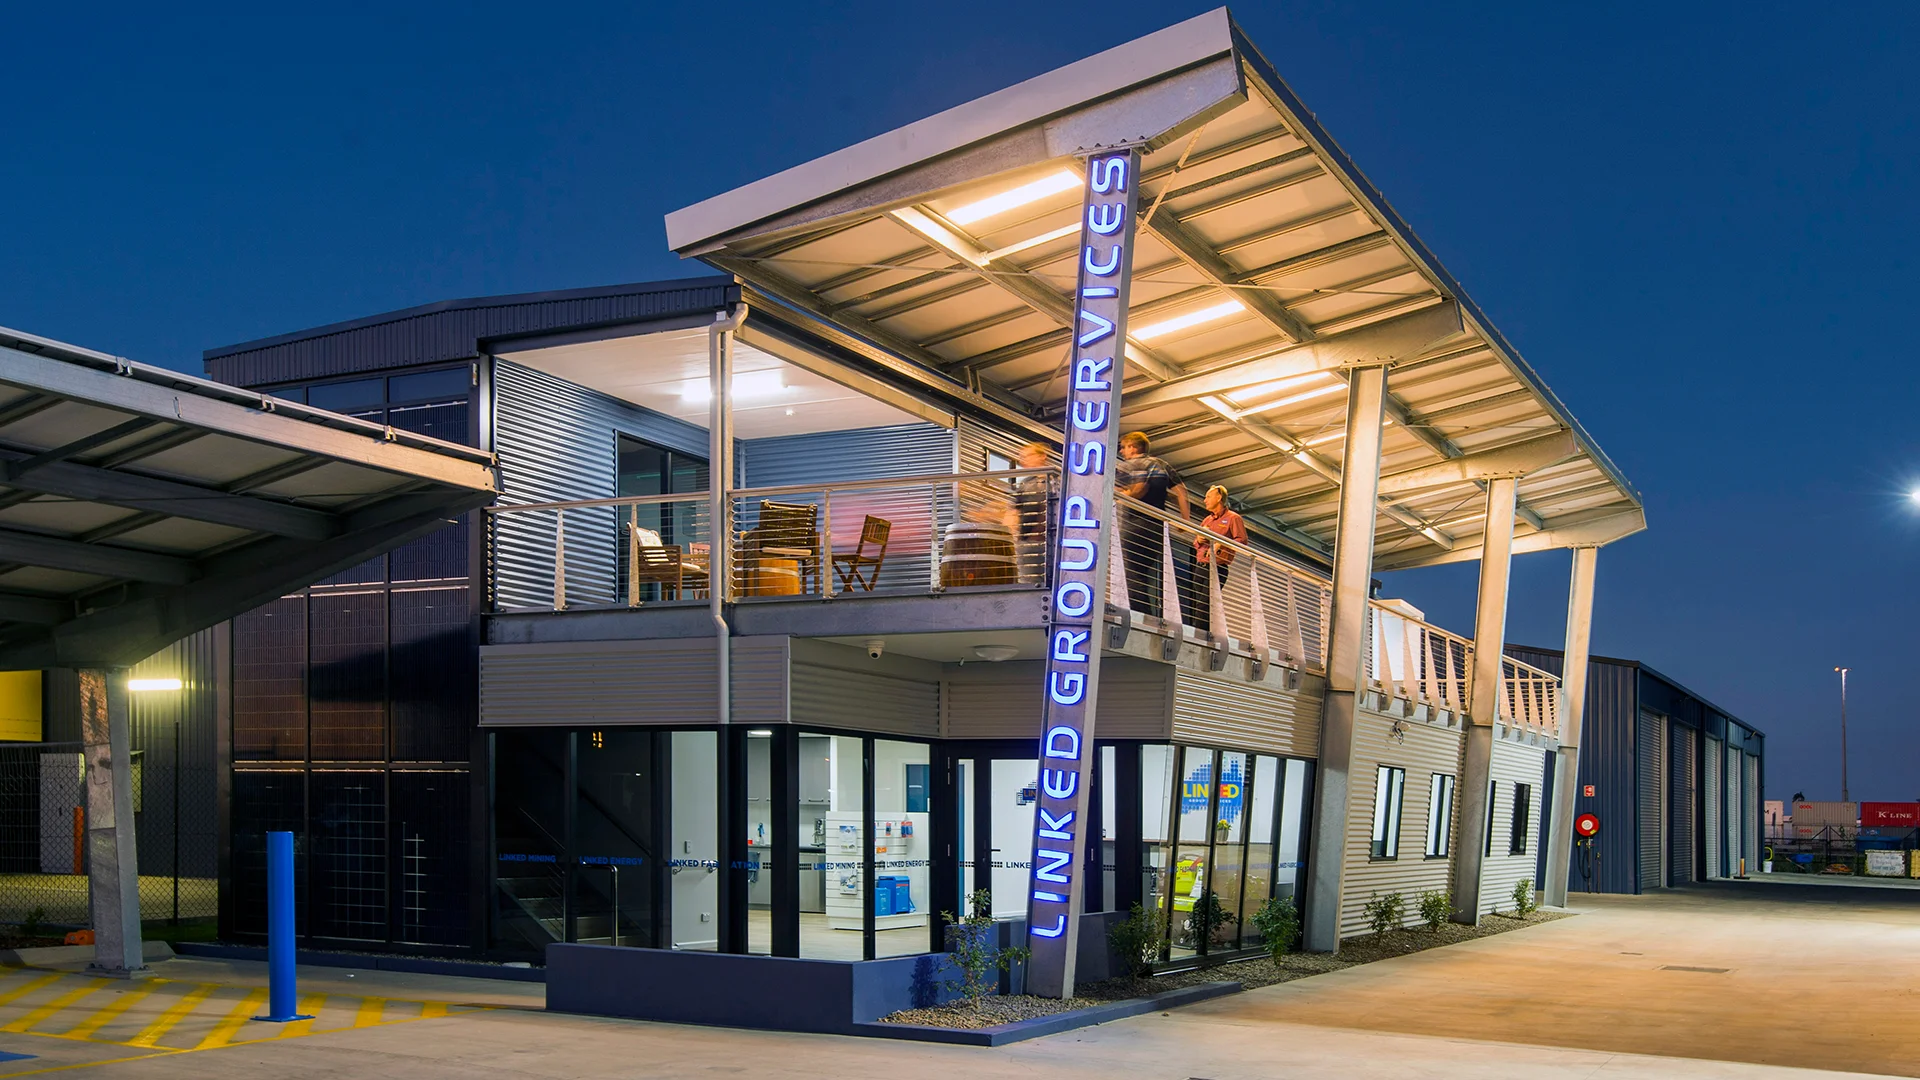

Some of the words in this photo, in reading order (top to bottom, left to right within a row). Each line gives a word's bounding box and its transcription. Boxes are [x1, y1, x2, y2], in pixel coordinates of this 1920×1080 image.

[1069, 156, 1127, 476] SERVICES
[1050, 495, 1099, 705] GROUP
[1183, 784, 1240, 798] LINED
[1031, 726, 1081, 939] LINKED
[499, 853, 527, 861] LINKED
[528, 854, 557, 863] MINING
[579, 856, 608, 865] LINKED
[610, 857, 643, 865] ENERGY
[813, 862, 834, 870] LINKED
[835, 862, 856, 870] MINING
